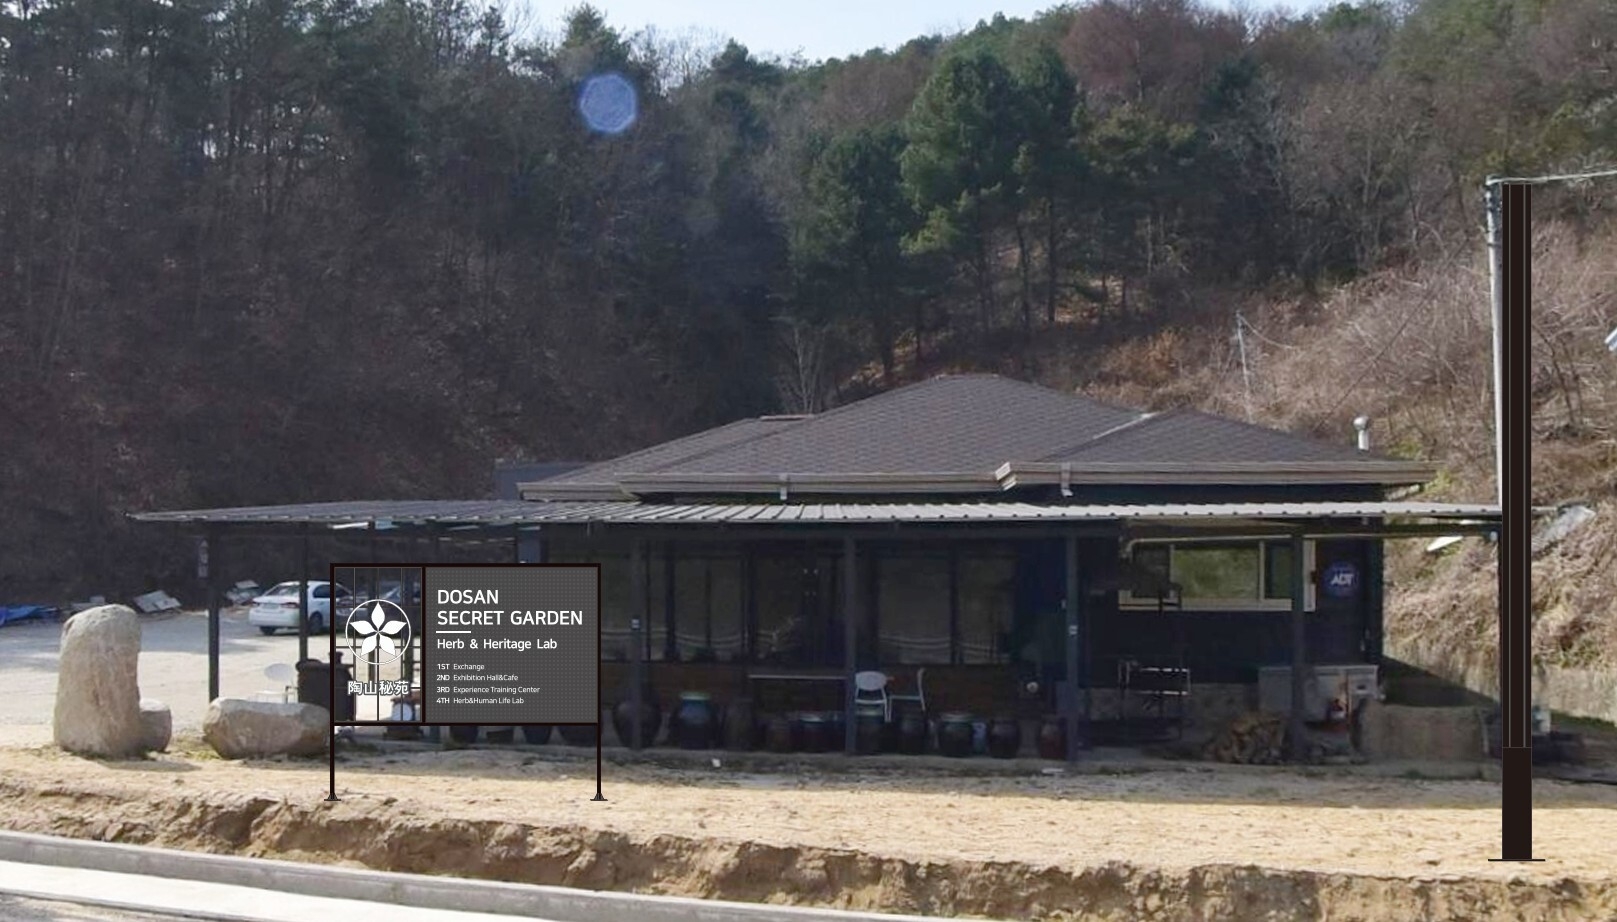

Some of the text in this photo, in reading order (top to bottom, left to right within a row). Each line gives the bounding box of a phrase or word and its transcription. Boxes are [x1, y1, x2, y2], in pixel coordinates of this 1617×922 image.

[1330, 573, 1354, 586] ADT
[437, 590, 499, 604] DOSAN
[437, 611, 583, 625] SECRET GARDEN
[437, 638, 558, 651] Herb & Heritage Lab
[453, 663, 485, 671] Exchange
[348, 680, 409, 695] 陶山秘苑
[453, 686, 490, 694] Experience
[490, 686, 517, 694] Training
